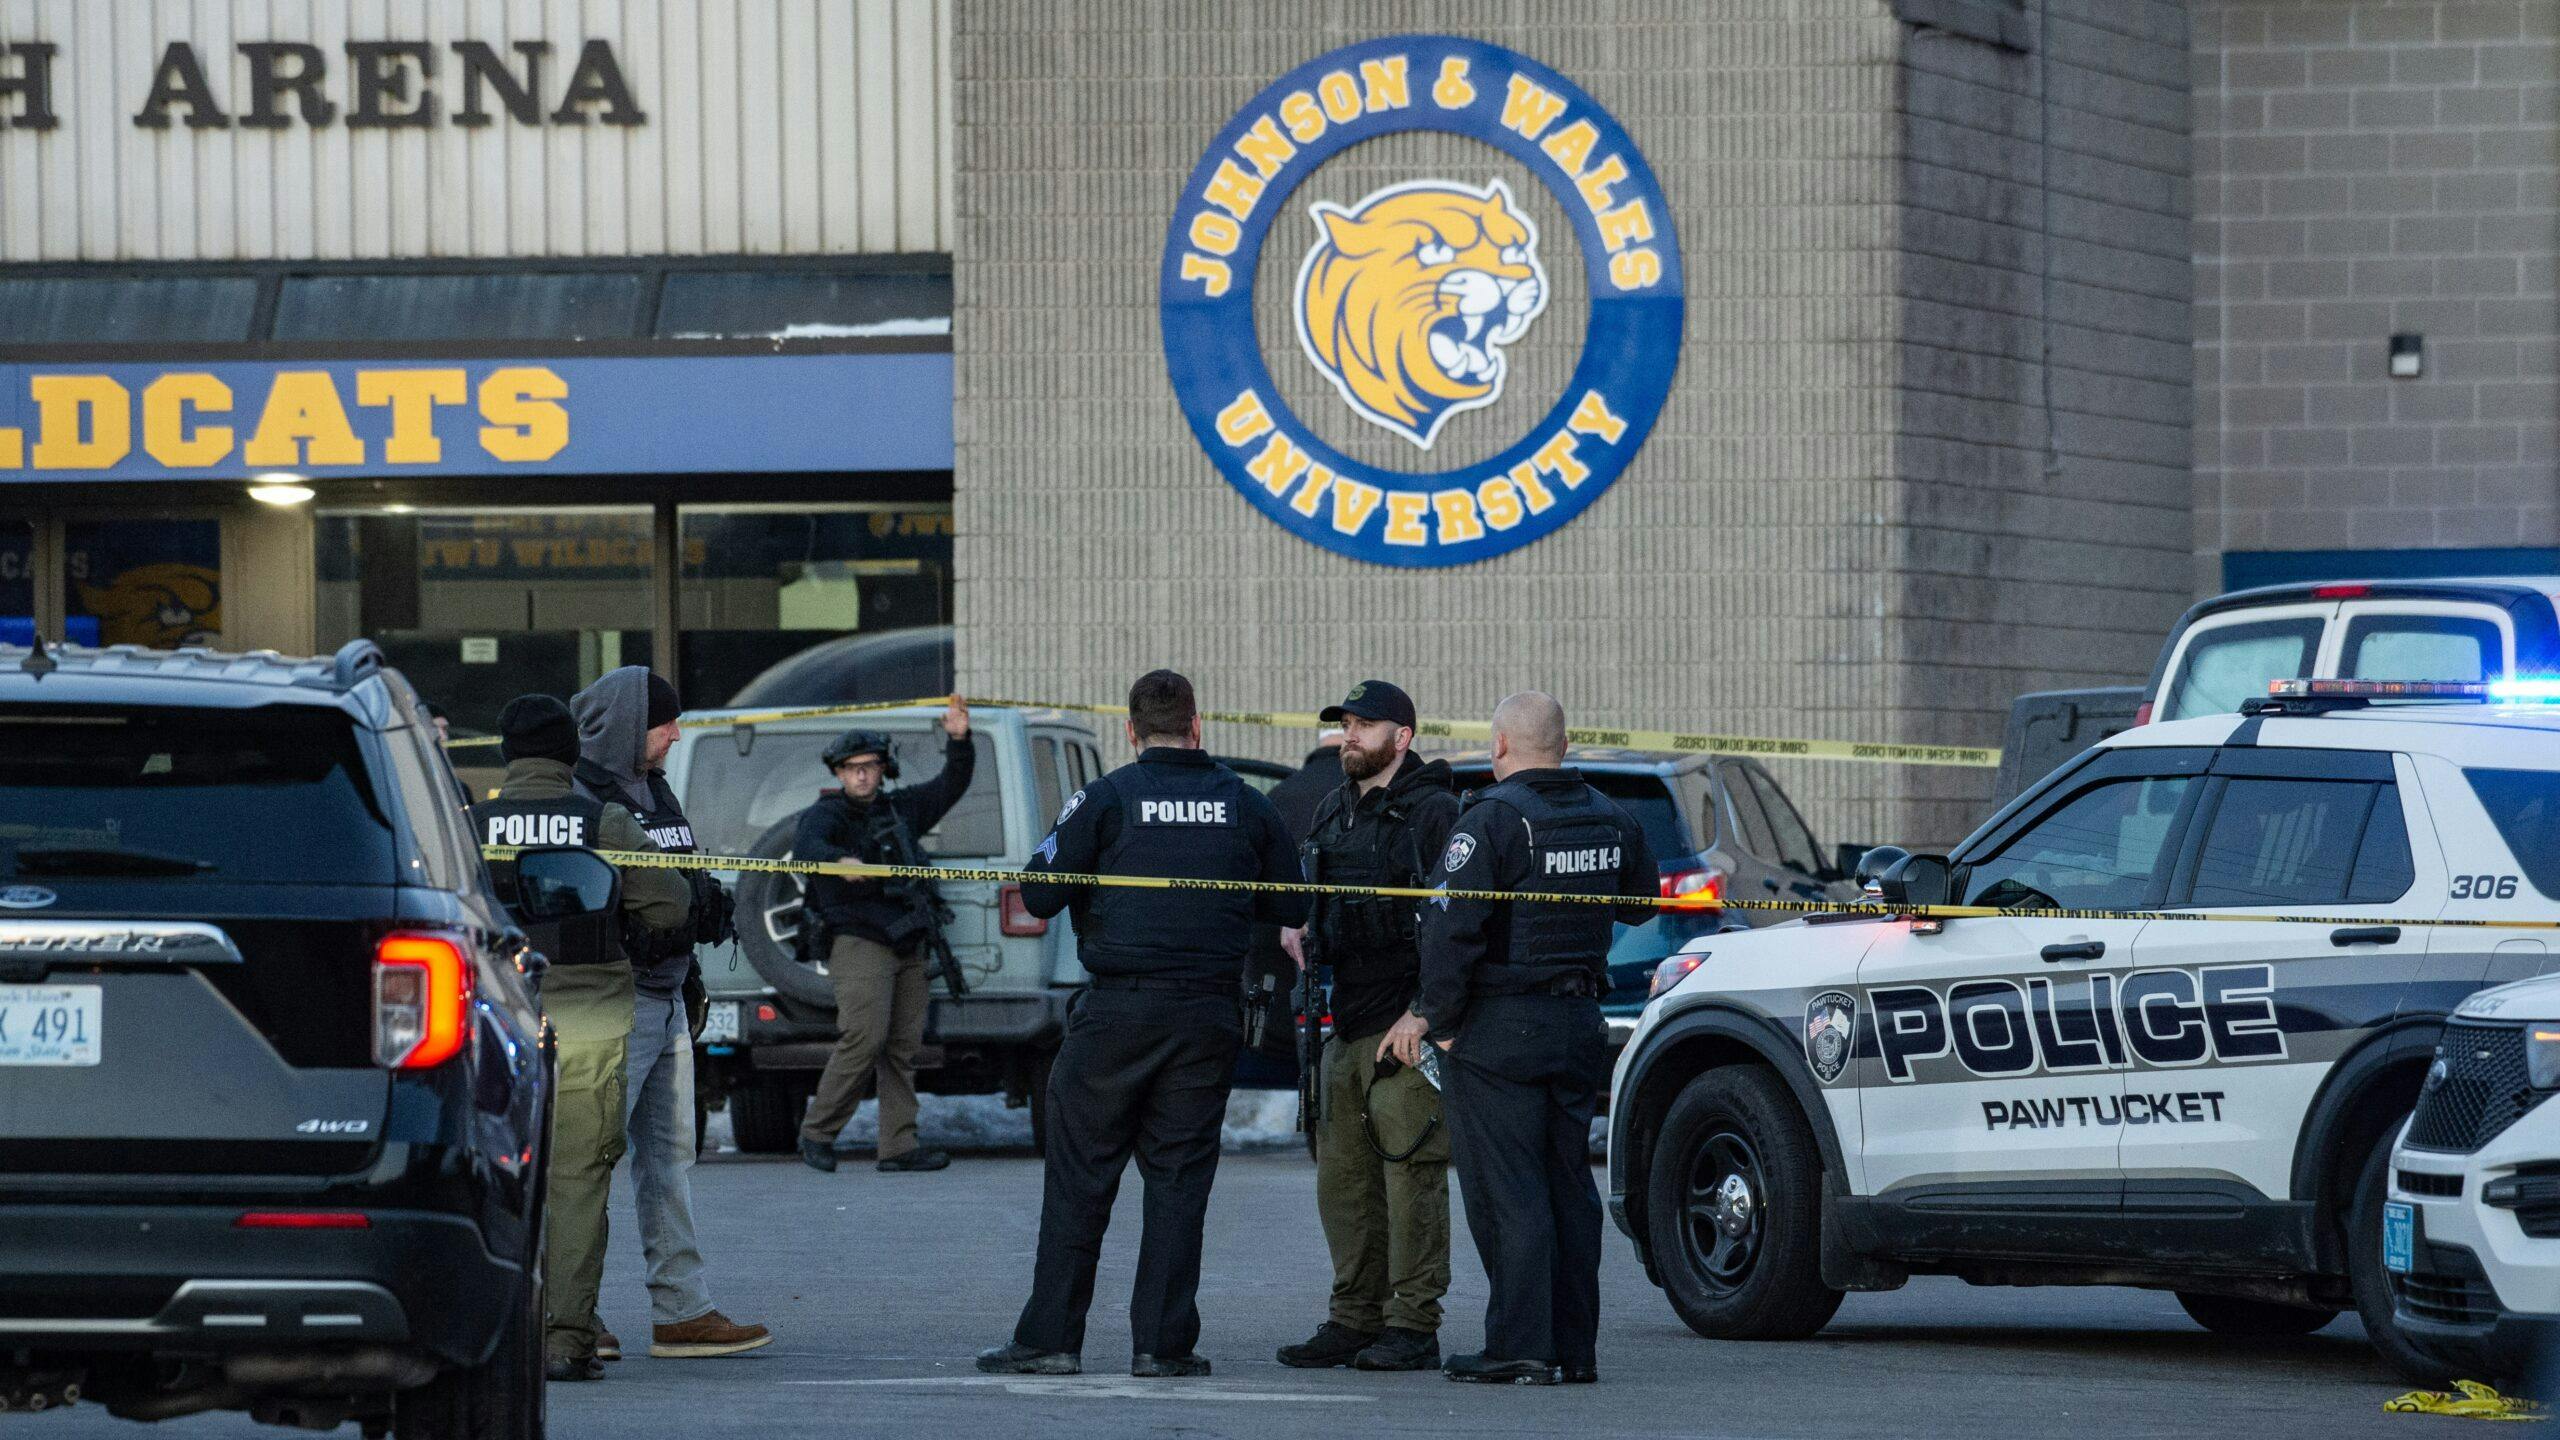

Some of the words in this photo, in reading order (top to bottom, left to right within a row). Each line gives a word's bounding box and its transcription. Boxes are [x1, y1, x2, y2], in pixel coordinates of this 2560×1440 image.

[132, 39, 648, 129] ARENA
[1180, 54, 1411, 297] JOHNSON
[1432, 55, 1477, 109] &
[1500, 74, 1661, 291] WALES
[0, 366, 570, 470] DCATS
[1215, 389, 1629, 547] UNIVERSITY
[1141, 800, 1227, 823] POLICE
[488, 814, 584, 846] POLICE
[644, 827, 682, 848] OLICE
[1545, 849, 1597, 874] POLICE
[1599, 846, 1621, 870] K-9
[2451, 875, 2519, 900] 306
[1811, 994, 1853, 1011] PAWTUCKET
[32, 1006, 88, 1044] 491
[1867, 963, 2289, 1083] POLICE
[1816, 1062, 1840, 1073] POLICE
[296, 1119, 368, 1133] 4WD
[1981, 1091, 2225, 1131] PAWTUCKET
